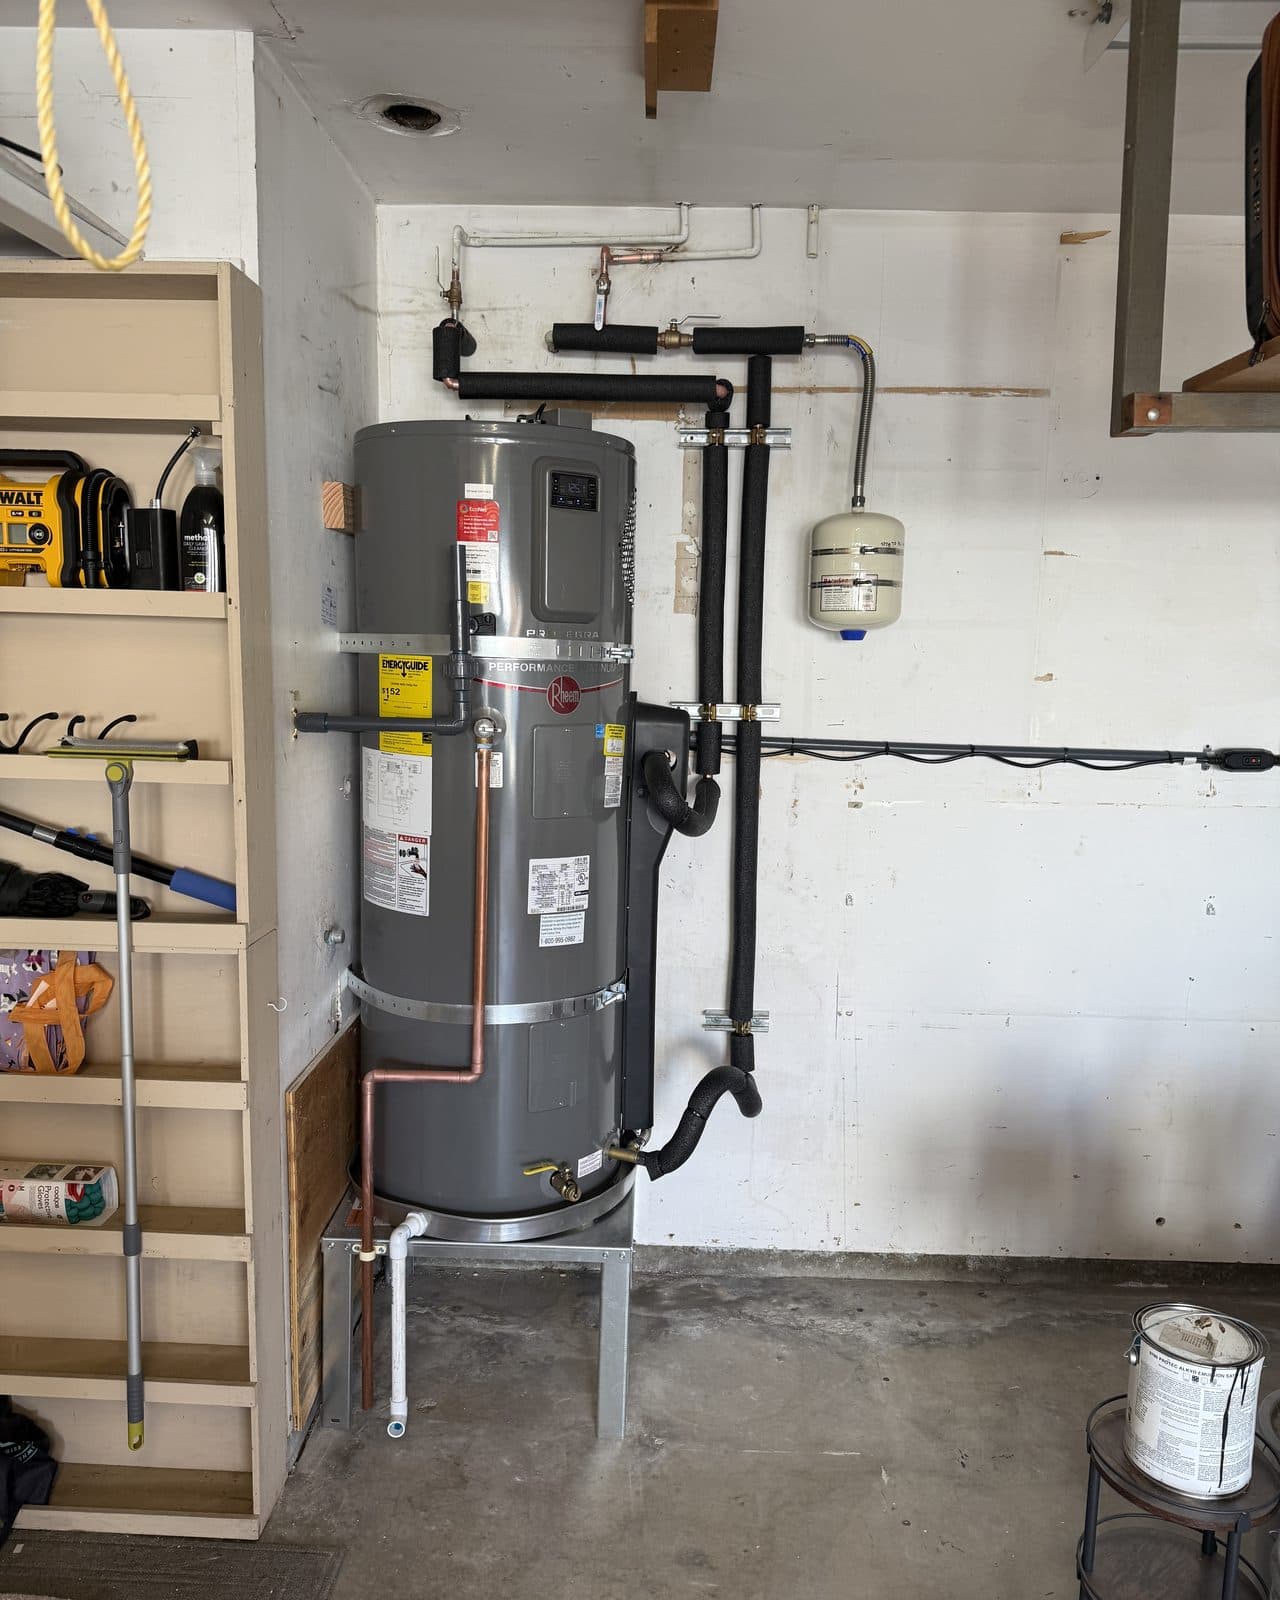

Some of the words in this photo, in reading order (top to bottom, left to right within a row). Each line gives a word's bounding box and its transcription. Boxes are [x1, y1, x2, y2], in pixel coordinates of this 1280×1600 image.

[488, 661, 575, 673] PERFORMANCE
[551, 677, 580, 708] Rheem
[37, 1185, 45, 1210] Gloves
